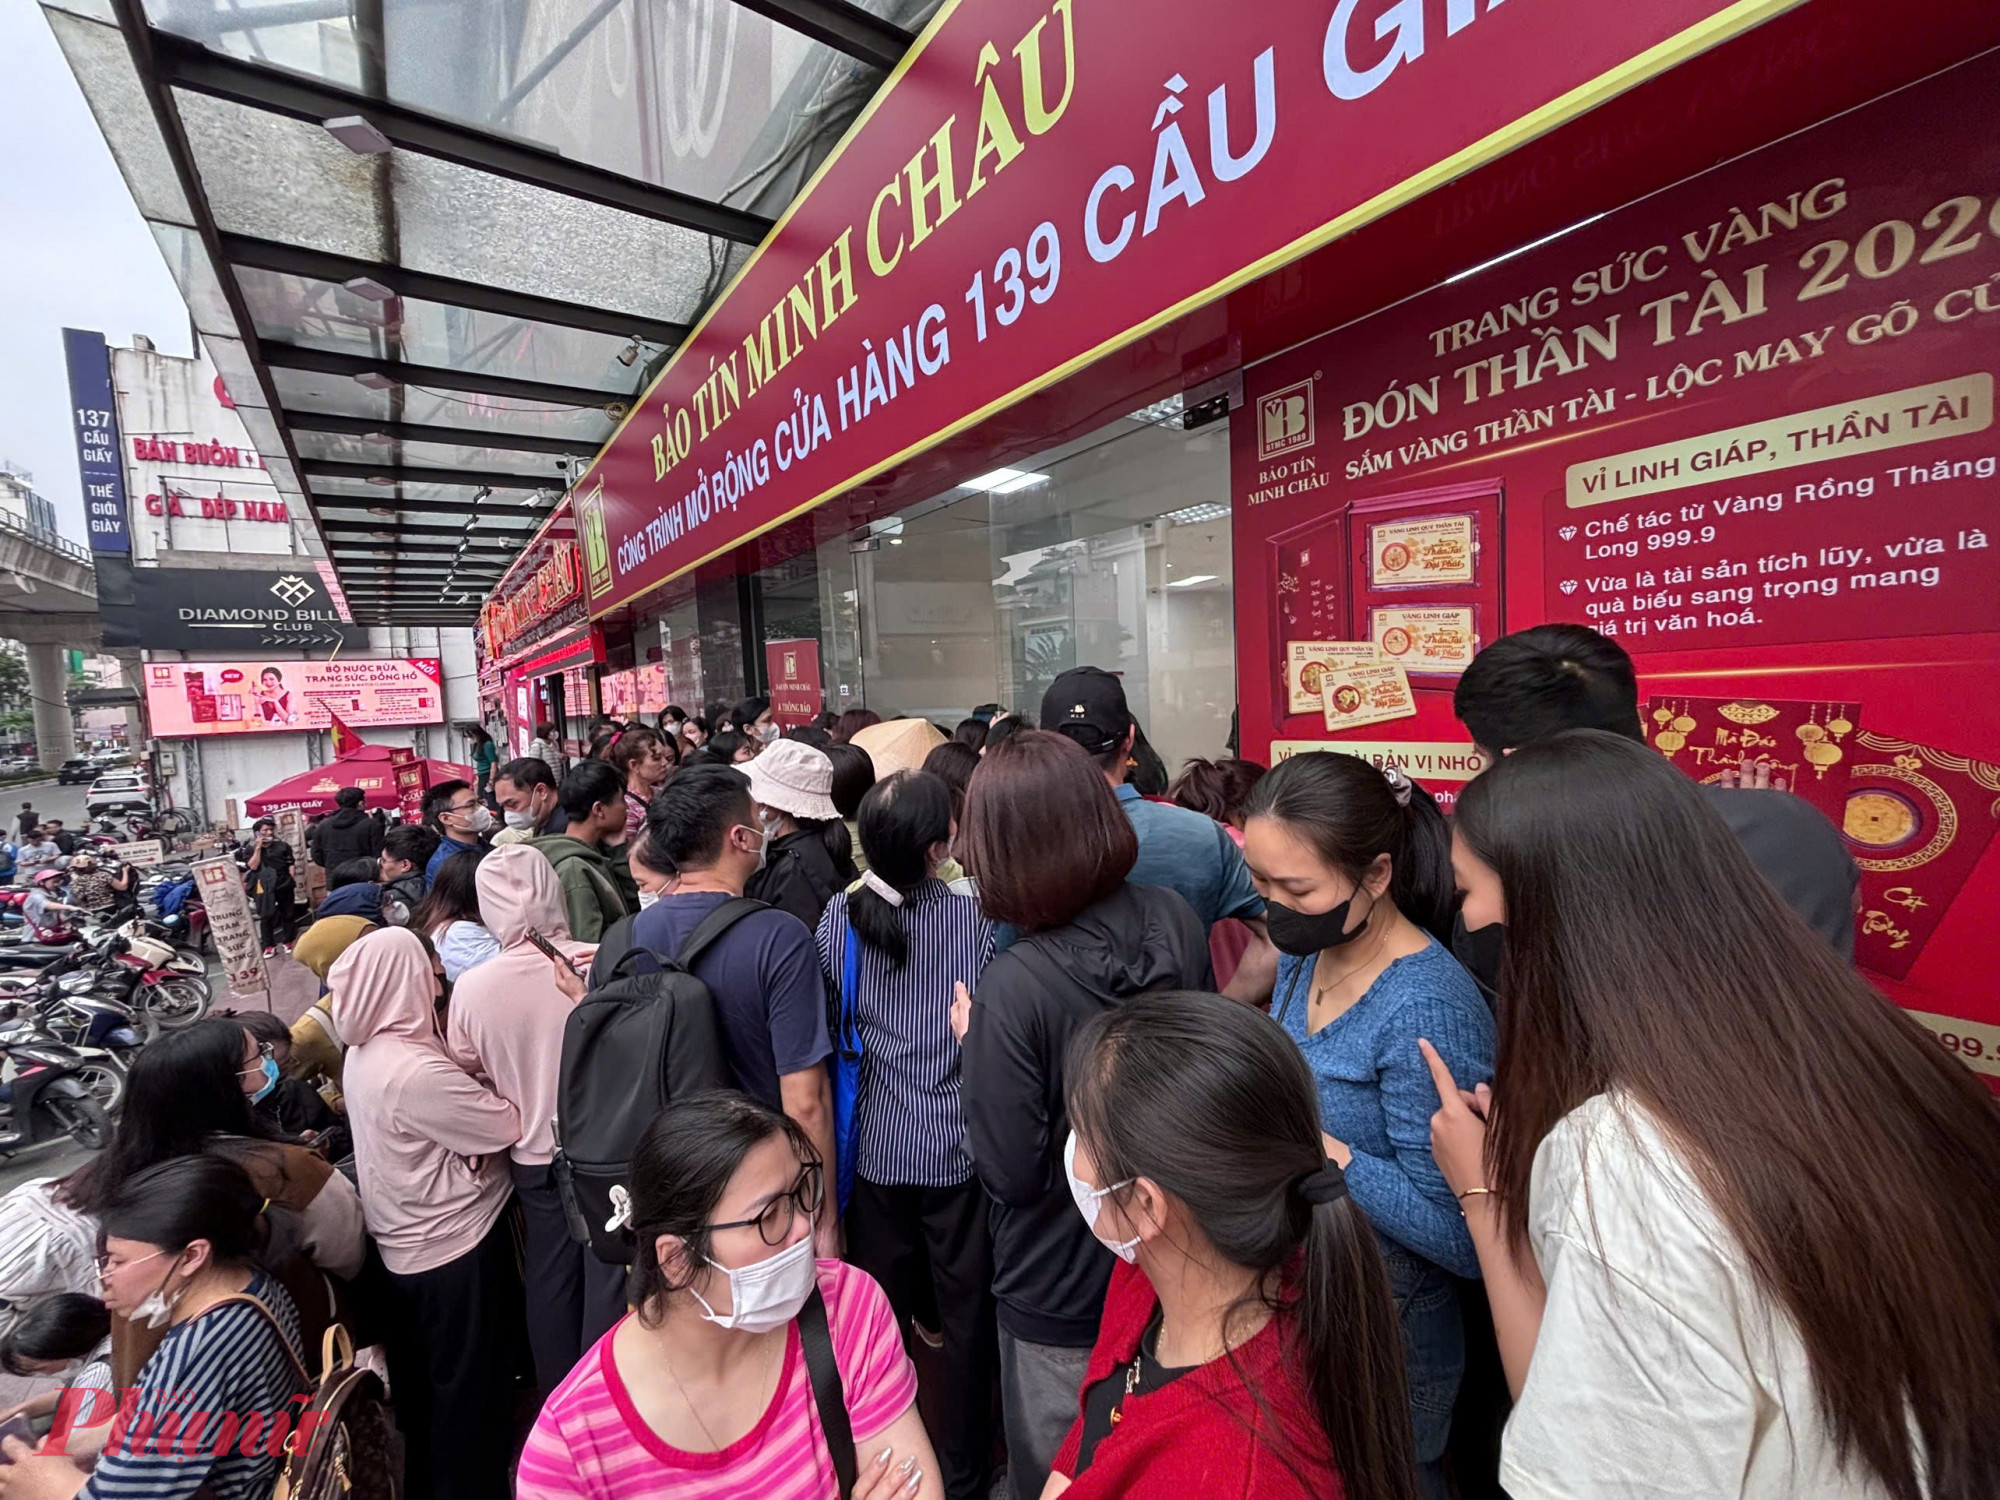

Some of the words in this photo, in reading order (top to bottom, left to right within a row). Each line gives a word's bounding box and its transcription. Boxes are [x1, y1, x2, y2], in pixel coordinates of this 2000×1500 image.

[651, 396, 691, 483] BẢO
[692, 354, 742, 442] TÍN
[742, 226, 859, 398] MINH
[865, 0, 1076, 278] CHÂU
[1429, 286, 1560, 358] TRANG
[1570, 245, 1669, 300] SỨC
[1681, 177, 1847, 266] VÀNG
[617, 526, 647, 576] CÔNG
[646, 500, 685, 556] TRÌNH
[685, 468, 711, 531] MỞ
[712, 440, 770, 512] RỘNG
[774, 388, 832, 473] CỦA
[837, 302, 951, 432] HÀNG
[965, 220, 1061, 342] 139
[1083, 45, 1276, 263] CẦU
[1342, 376, 1441, 441] ĐÓN
[1453, 312, 1622, 405] THẦN
[1640, 263, 1769, 347] TÀI
[1345, 448, 1393, 481] SẮM
[1398, 430, 1468, 466] VÀNG
[1474, 405, 1554, 447] THẦN
[1560, 388, 1616, 422] TÀI
[1646, 360, 1724, 402] LỘC
[1734, 326, 1835, 378] MAY
[1847, 300, 1918, 346] GÕ
[78, 408, 110, 428] 137
[84, 430, 109, 445] CẦU
[1288, 432, 1306, 445] 1989
[1582, 466, 1608, 495] VỈ
[1614, 457, 1680, 489] LINH
[1690, 438, 1777, 473] GIÁP,
[1787, 409, 1890, 455] THẦN
[1902, 394, 1970, 429] TÀI
[84, 448, 112, 463] GIẤY
[183, 438, 239, 466] BUÔN
[1259, 465, 1288, 484] BẢO
[1290, 456, 1316, 475] TÍN
[88, 483, 115, 498] THẾ
[1247, 485, 1285, 506] MINH
[1288, 472, 1330, 494] CHÂU
[1585, 512, 1630, 539] Chế
[1637, 508, 1673, 530] tác
[1679, 502, 1706, 523] từ
[1713, 489, 1784, 519] Vàng
[1795, 473, 1875, 504] Rồng
[1886, 455, 1996, 489] Thăng
[92, 501, 118, 516] GIỚI
[244, 500, 289, 523] NAM
[91, 518, 120, 532] GIÀY
[1585, 538, 1639, 562] Long
[1647, 524, 1717, 552] 999.9
[1585, 575, 1628, 594] Vừa
[1636, 570, 1655, 588] là
[1664, 566, 1692, 584] tài
[1700, 558, 1748, 580] sản
[1757, 548, 1808, 573] tích
[1884, 536, 1944, 559] vừa
[1958, 528, 1988, 551] là
[1586, 597, 1625, 618] quà
[1633, 590, 1682, 611] biếu
[1691, 586, 1754, 604] sang
[1763, 573, 1840, 602] trọng
[1850, 564, 1941, 591] mang
[179, 608, 289, 621] DIAMOND
[296, 609, 340, 621] BILL
[1402, 612, 1421, 620] VÀNG
[1423, 612, 1440, 620] LINH
[1624, 616, 1647, 636] trị
[1654, 613, 1697, 632] văn
[1707, 607, 1763, 628] hoá.
[272, 622, 314, 631] CLUB
[326, 664, 342, 674] BỘ
[376, 663, 398, 672] RỬA
[416, 661, 436, 676] MỚI
[782, 700, 800, 712] THÔNG
[800, 701, 811, 714] BÁO
[1415, 755, 1432, 773] VỊ
[1438, 750, 1482, 771] NHỎ
[262, 804, 278, 812] 139
[301, 799, 324, 809] GIẤY
[212, 909, 242, 921] TRUNG
[218, 930, 250, 942] TRANG
[228, 952, 253, 964] BTMC
[231, 968, 258, 982] 139
